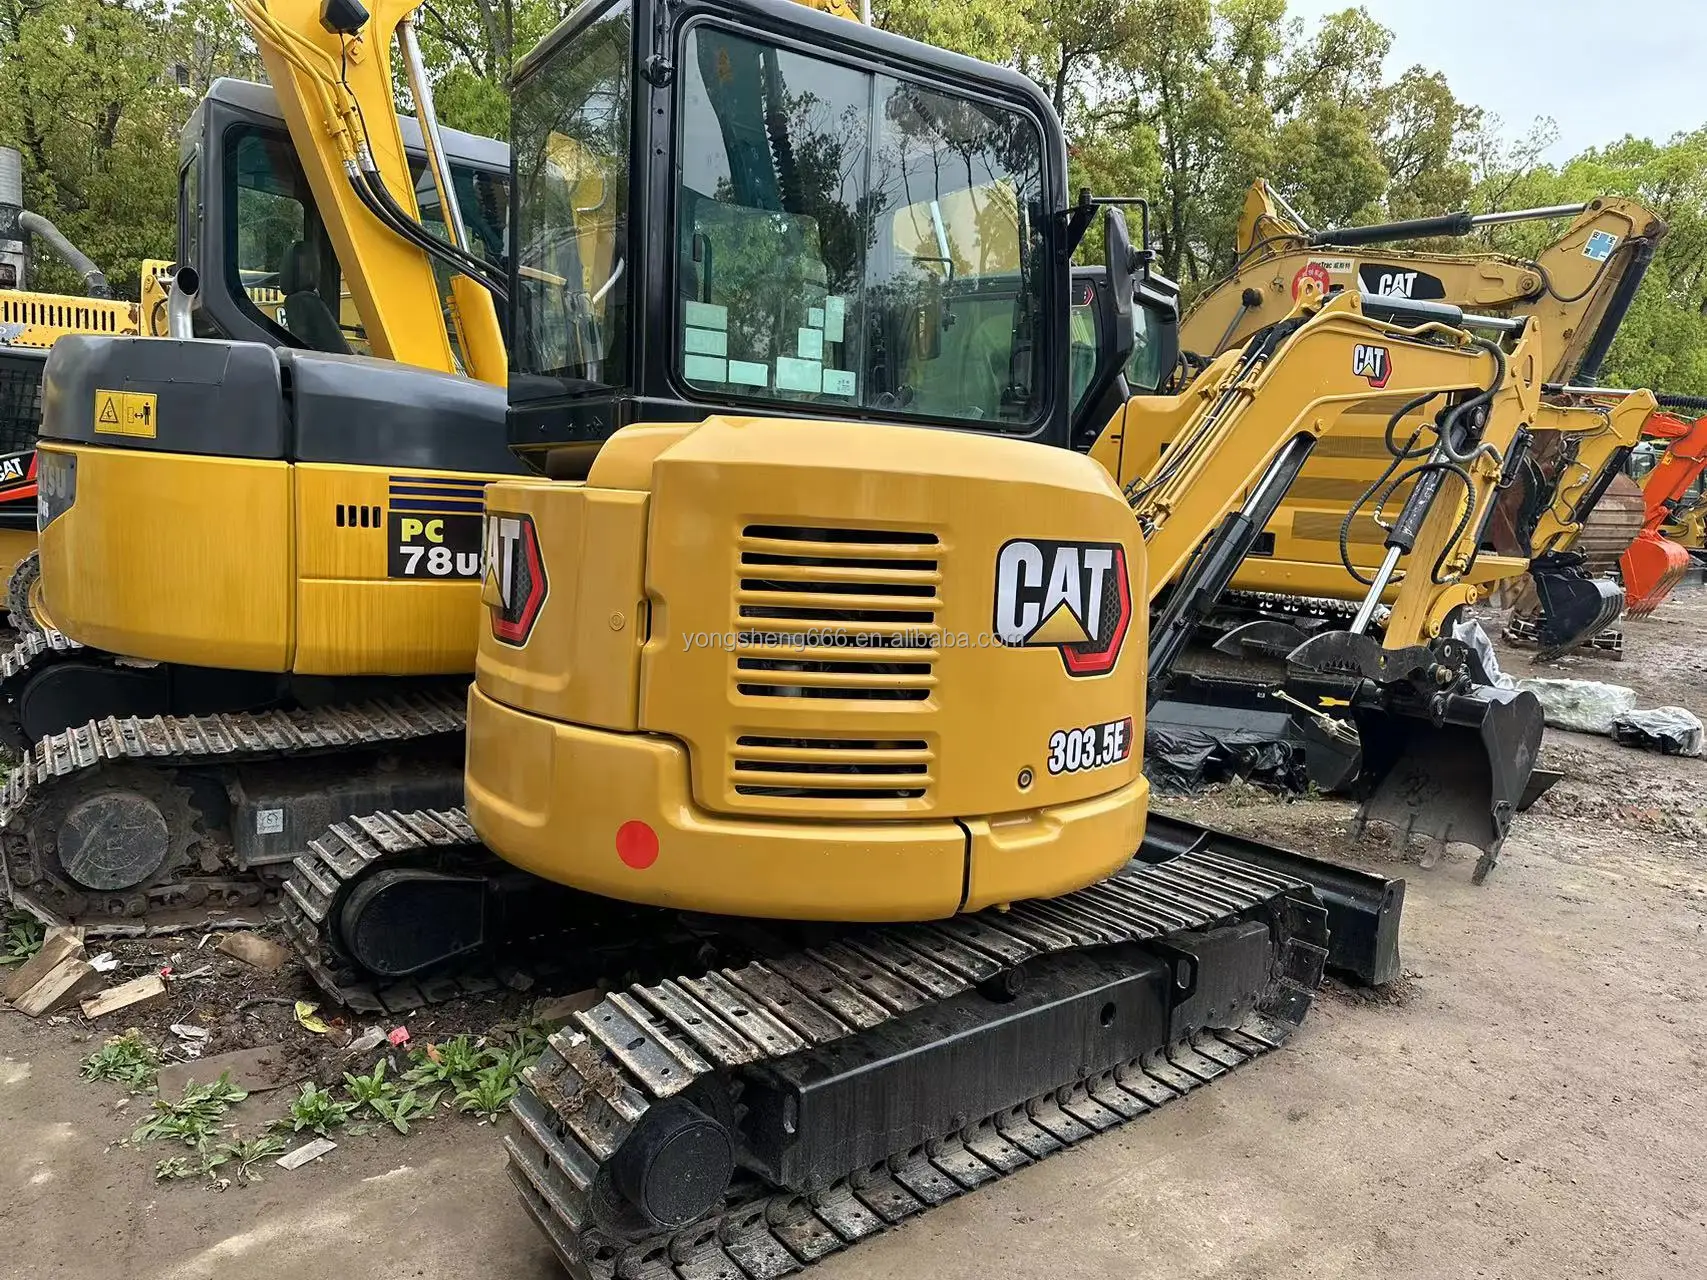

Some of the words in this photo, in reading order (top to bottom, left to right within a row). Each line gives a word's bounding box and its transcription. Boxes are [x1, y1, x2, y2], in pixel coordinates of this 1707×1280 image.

[1379, 272, 1418, 298] CAT
[1353, 344, 1384, 377] CAT
[401, 518, 444, 543] PC
[400, 546, 482, 576] 78U
[482, 515, 520, 609] AT
[997, 541, 1113, 643] CAT
[1049, 720, 1125, 773] 303.5E
